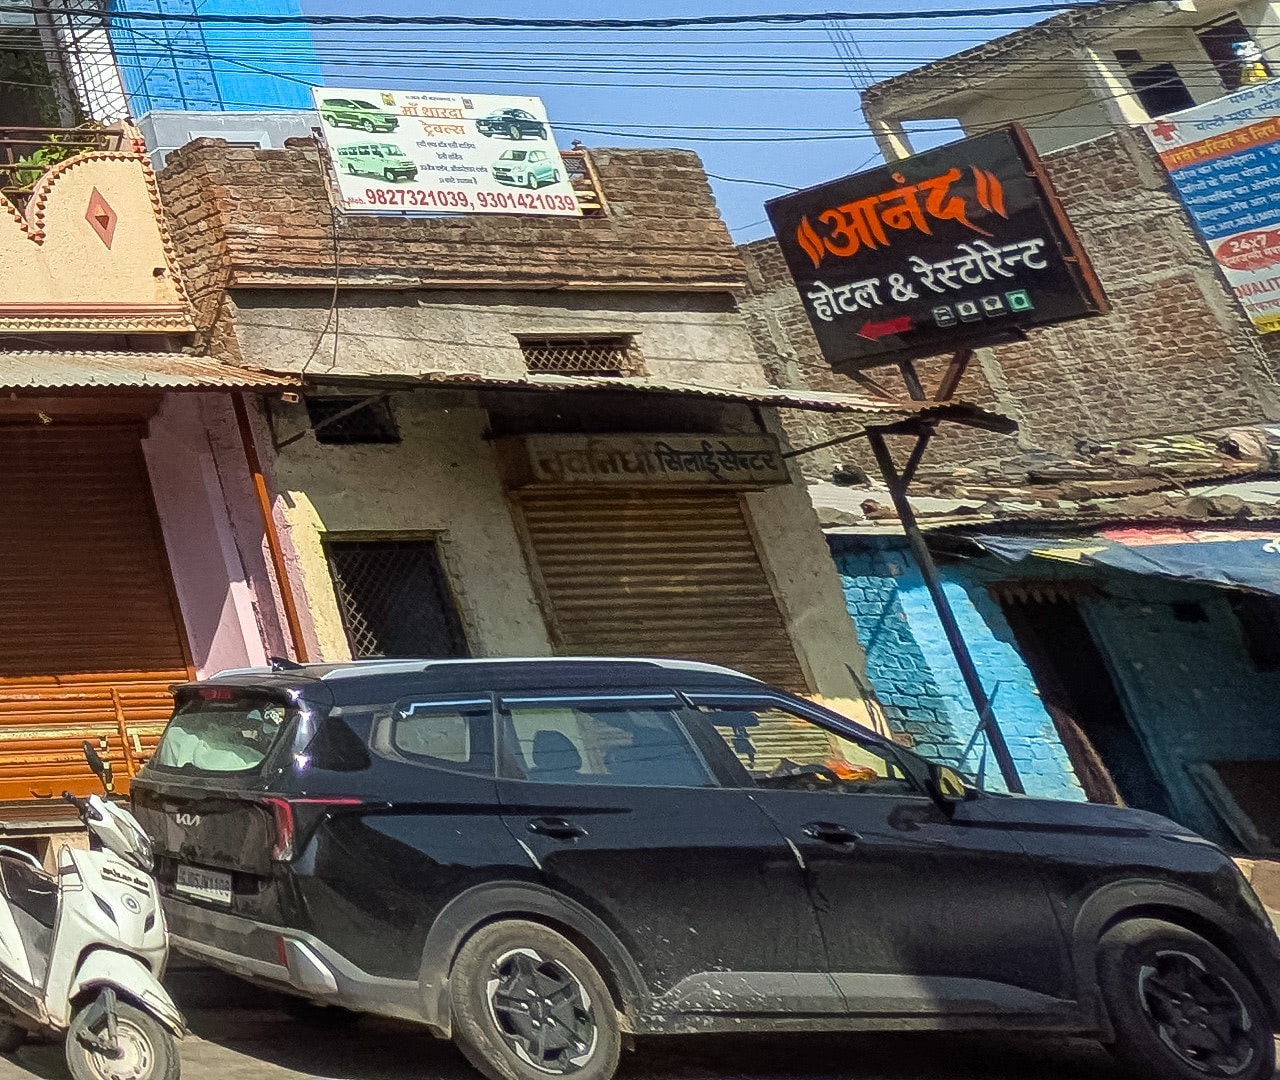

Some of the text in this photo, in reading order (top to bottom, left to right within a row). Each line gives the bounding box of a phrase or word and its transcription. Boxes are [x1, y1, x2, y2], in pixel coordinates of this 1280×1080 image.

[400, 102, 464, 119] माँ शारदा
[418, 120, 466, 137] ट्रेवल्स
[365, 188, 475, 210] 9827321039,
[476, 191, 576, 211] 9301421039
[808, 237, 1048, 323] होटल & रेस्टोरेन्ट
[652, 439, 722, 480] सिलाई
[717, 440, 777, 471] सेन्टर
